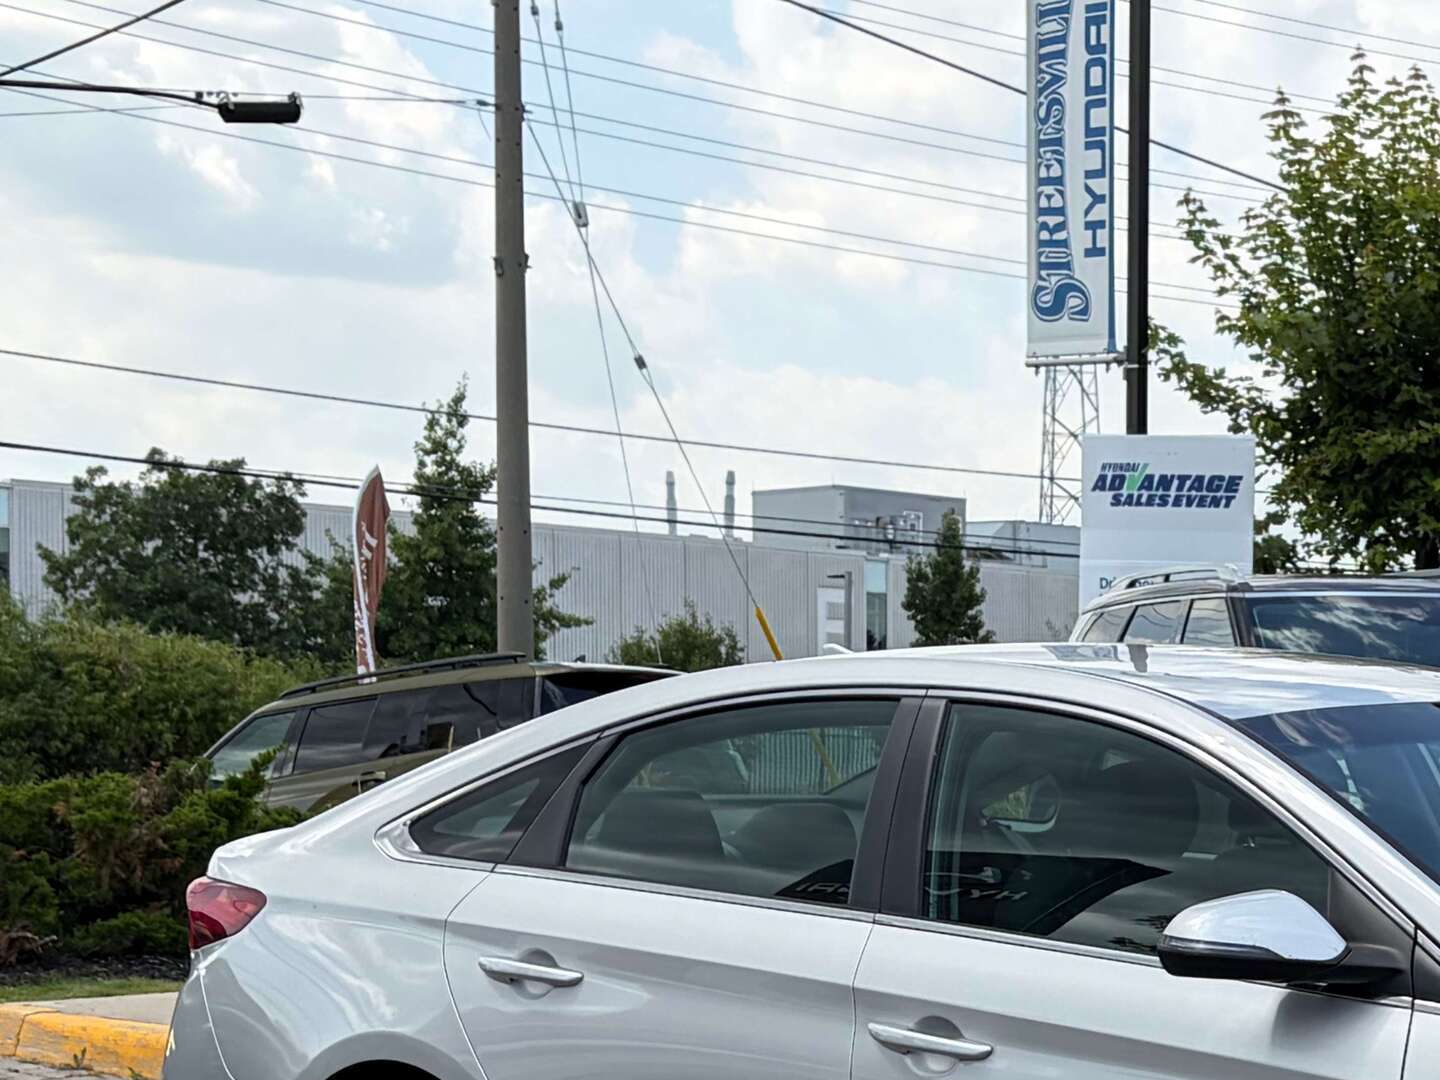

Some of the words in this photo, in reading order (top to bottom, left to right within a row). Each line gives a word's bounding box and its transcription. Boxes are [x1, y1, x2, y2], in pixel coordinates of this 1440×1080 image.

[1084, 1, 1108, 258] HYUNDAI
[1100, 463, 1140, 473] HYUNDAI
[1110, 493, 1171, 507] SALES
[1171, 494, 1236, 508] EVENT
